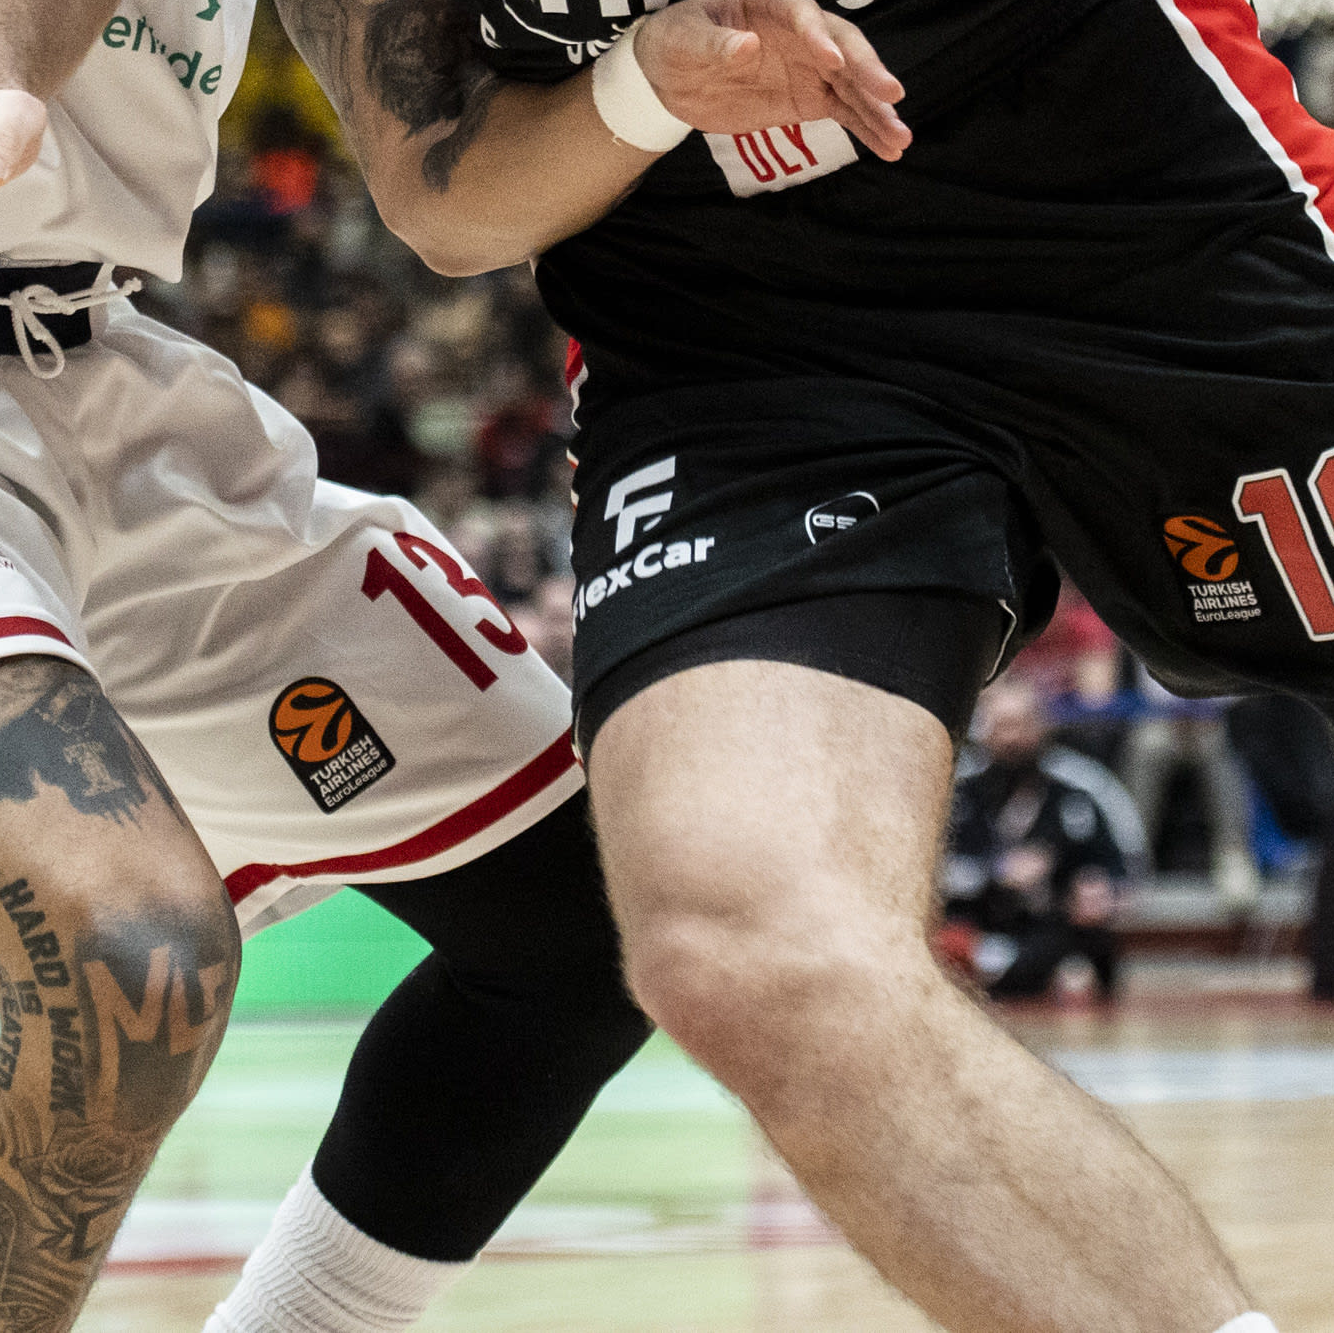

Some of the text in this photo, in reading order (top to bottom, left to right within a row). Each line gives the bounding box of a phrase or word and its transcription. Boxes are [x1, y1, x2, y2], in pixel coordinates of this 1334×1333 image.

[573, 536, 715, 622] lexCar
[1187, 581, 1253, 597] TURKISH
[1194, 594, 1258, 611] AIRLINES
[361, 531, 528, 692] 13
[1195, 609, 1261, 623] EuroLeague
[309, 735, 373, 785] TURKISH
[319, 747, 380, 798] AIRLINES
[324, 759, 387, 807] EuroLeague
